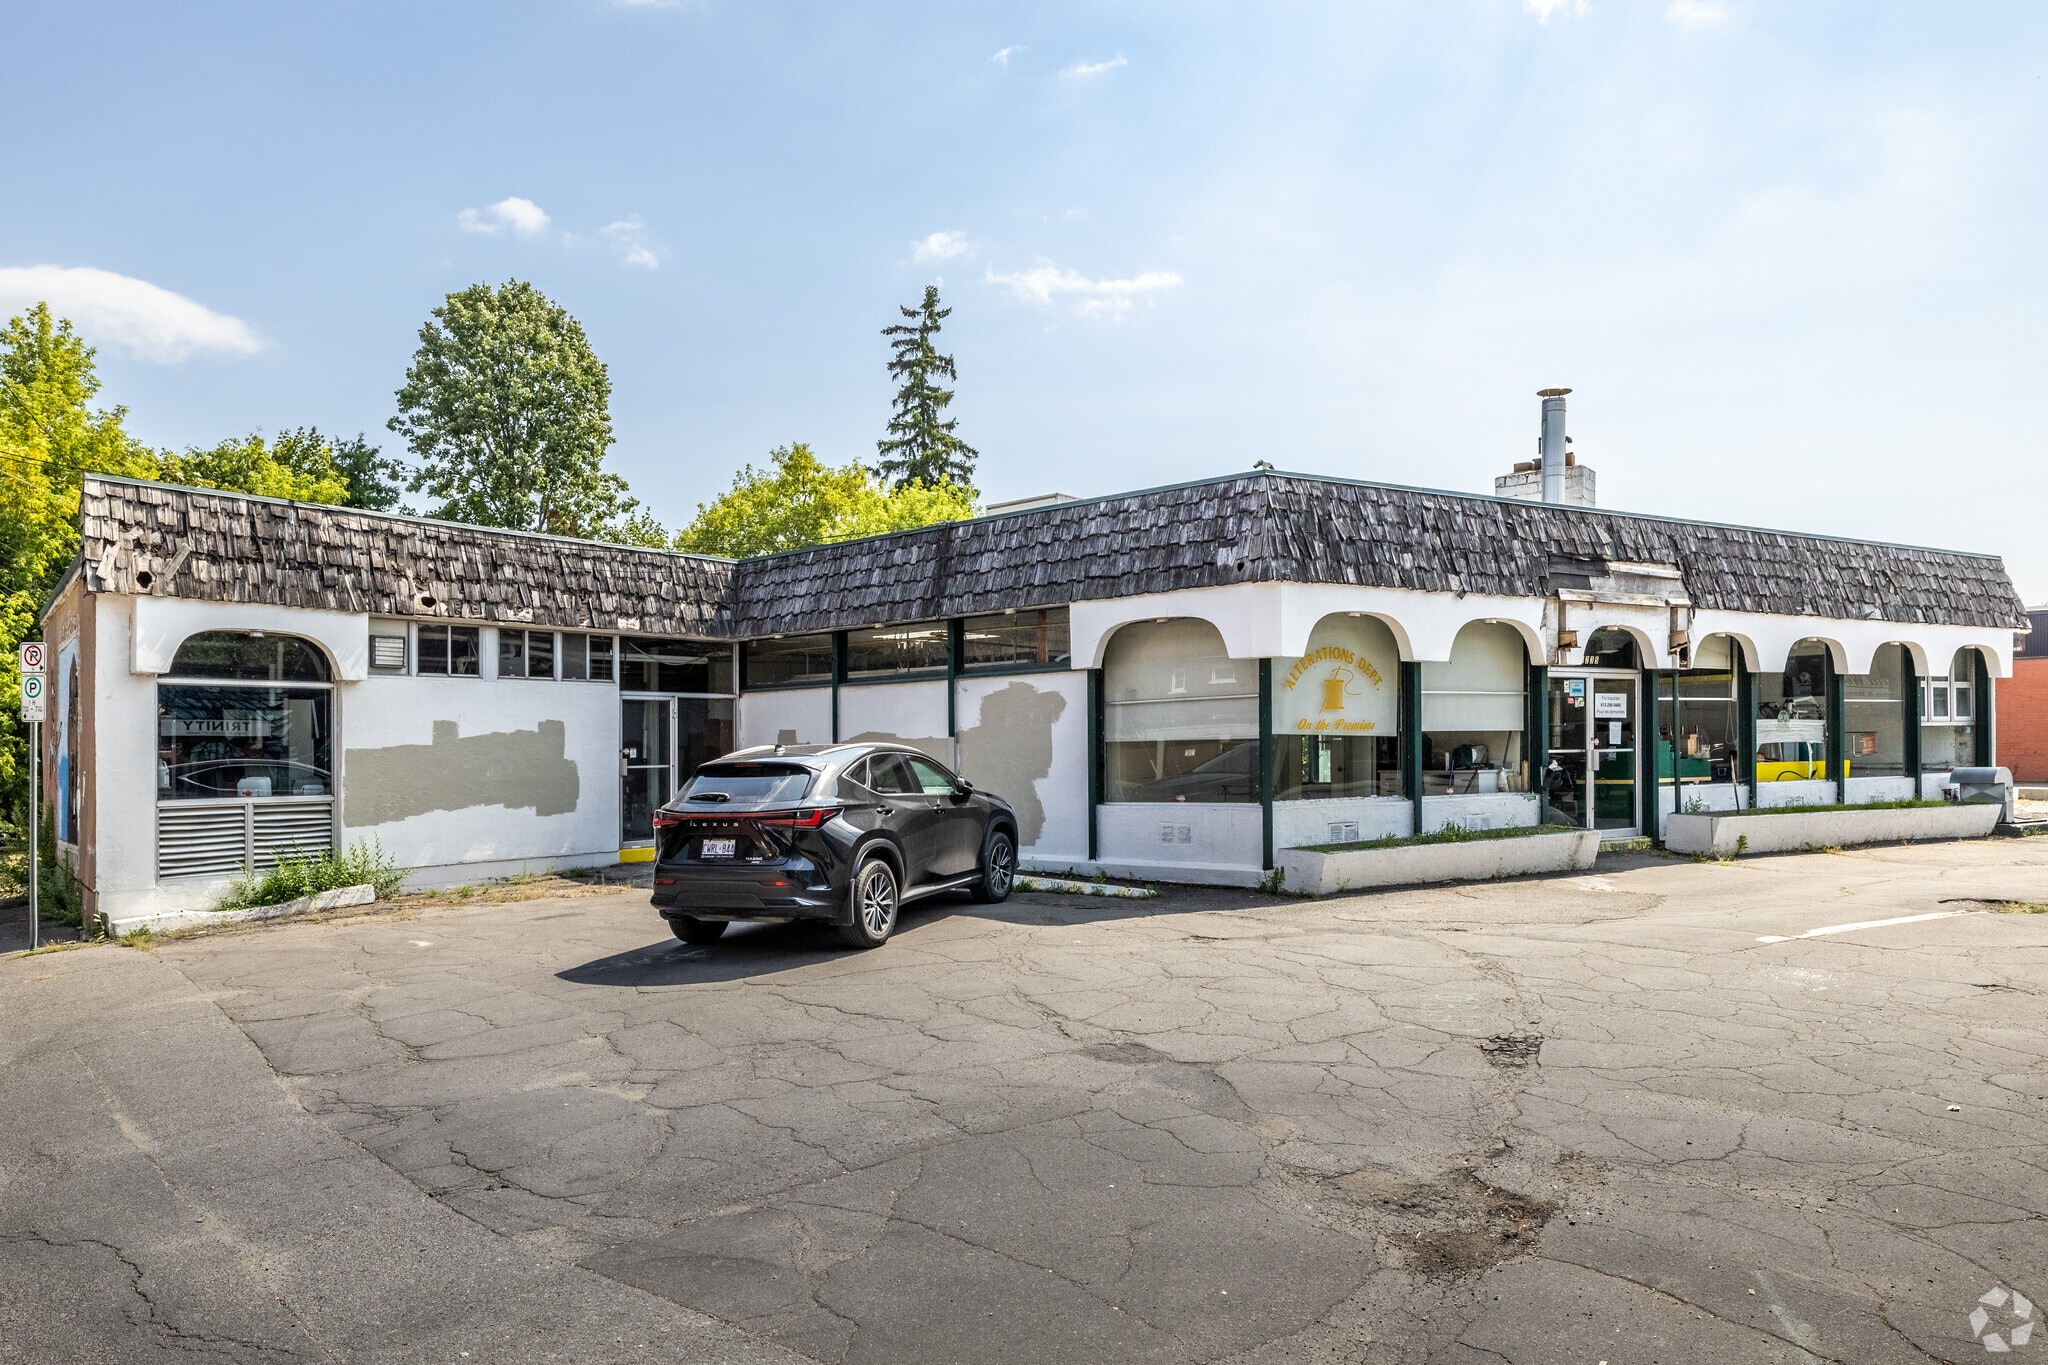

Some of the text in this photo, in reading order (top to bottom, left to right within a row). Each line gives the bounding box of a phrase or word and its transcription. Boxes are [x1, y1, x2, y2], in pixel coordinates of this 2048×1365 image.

[1285, 646, 1383, 691] ALTERATIONS DEPT.
[30, 682, 37, 693] P
[1297, 718, 1376, 731] On the Premises
